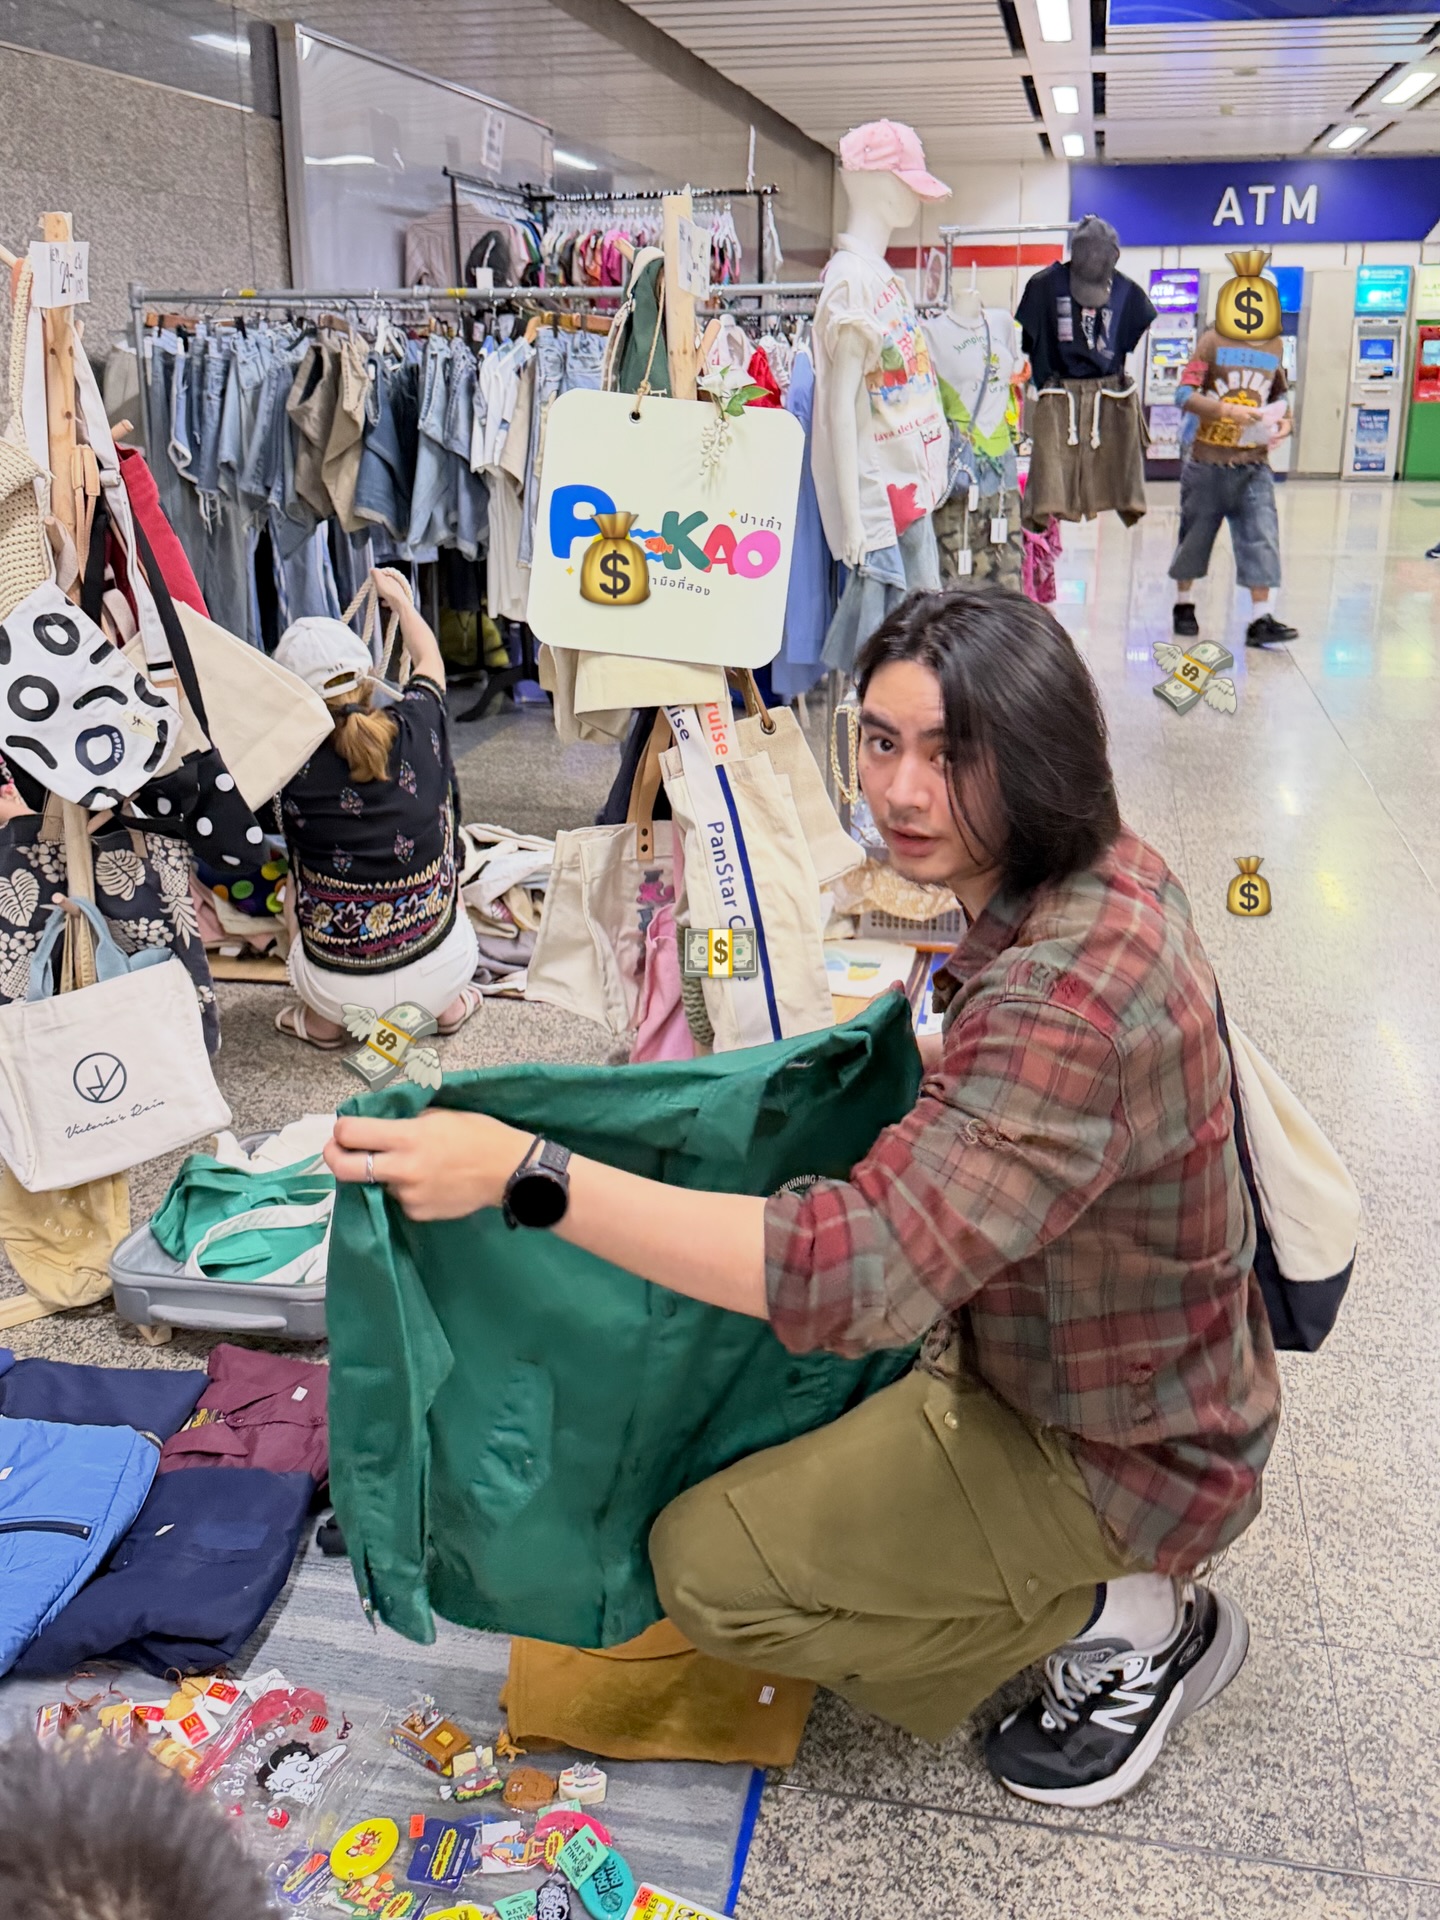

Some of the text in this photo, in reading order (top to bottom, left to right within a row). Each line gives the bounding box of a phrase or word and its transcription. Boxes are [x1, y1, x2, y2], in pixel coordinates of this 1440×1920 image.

[1212, 184, 1318, 226] ATM
[549, 484, 781, 579] PKAO
[648, 576, 711, 596] ามือที่สอง
[704, 701, 729, 756] ruise
[706, 820, 738, 908] PanStar
[65, 1114, 127, 1139] Victoria's
[245, 1726, 286, 1754] Boop
[642, 1897, 659, 1920] EYES
